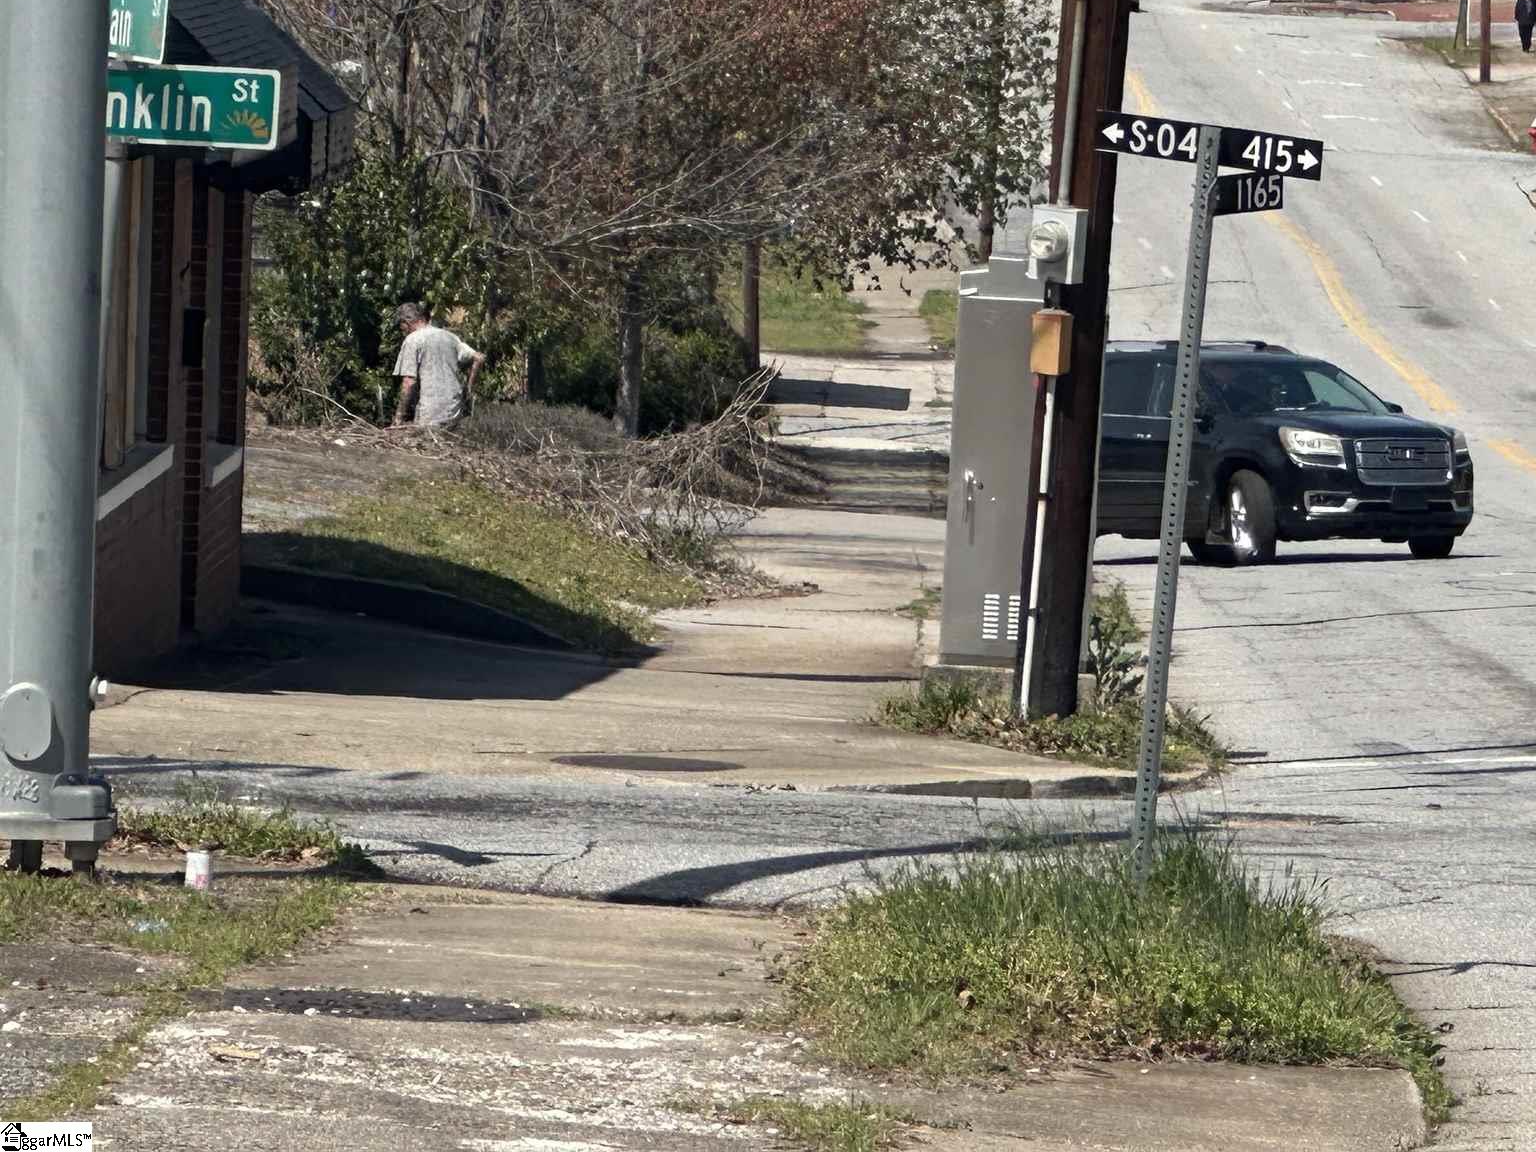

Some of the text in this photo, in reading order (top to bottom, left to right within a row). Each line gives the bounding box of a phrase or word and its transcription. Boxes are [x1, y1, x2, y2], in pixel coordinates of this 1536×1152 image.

[105, 77, 260, 133] nklin St
[1241, 135, 1294, 173] 415
[1237, 175, 1282, 210] 1165
